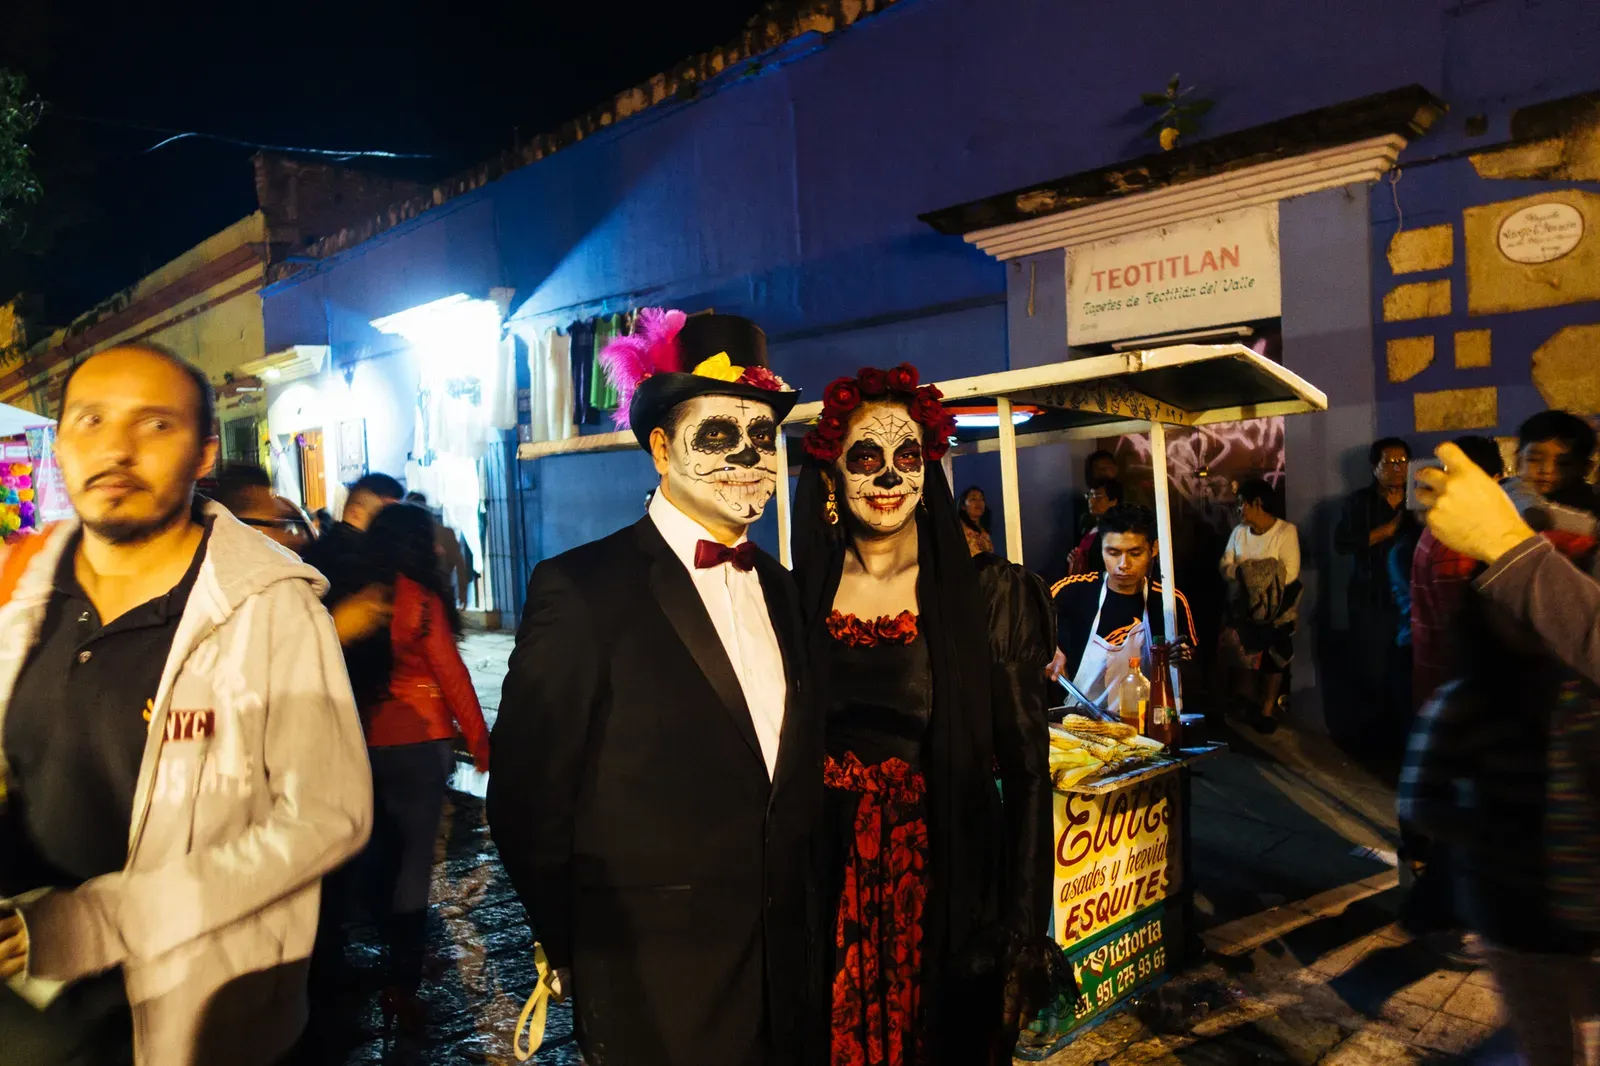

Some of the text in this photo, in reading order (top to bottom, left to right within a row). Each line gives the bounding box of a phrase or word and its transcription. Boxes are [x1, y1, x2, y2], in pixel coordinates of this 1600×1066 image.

[1091, 244, 1241, 293] TEOTITLAN
[1083, 299, 1122, 316] Tapetes
[1126, 294, 1140, 308] de
[1199, 281, 1218, 296] del
[1223, 275, 1255, 293] Valle
[166, 710, 208, 743] NYC
[1060, 861, 1107, 903] asados
[1111, 859, 1122, 887] y
[1064, 862, 1171, 941] ESQUITES
[1083, 920, 1163, 974] Victoria
[1096, 976, 1115, 1006] 951
[1116, 963, 1136, 993] 275
[1138, 953, 1152, 978] 93
[1153, 946, 1166, 970] 67
